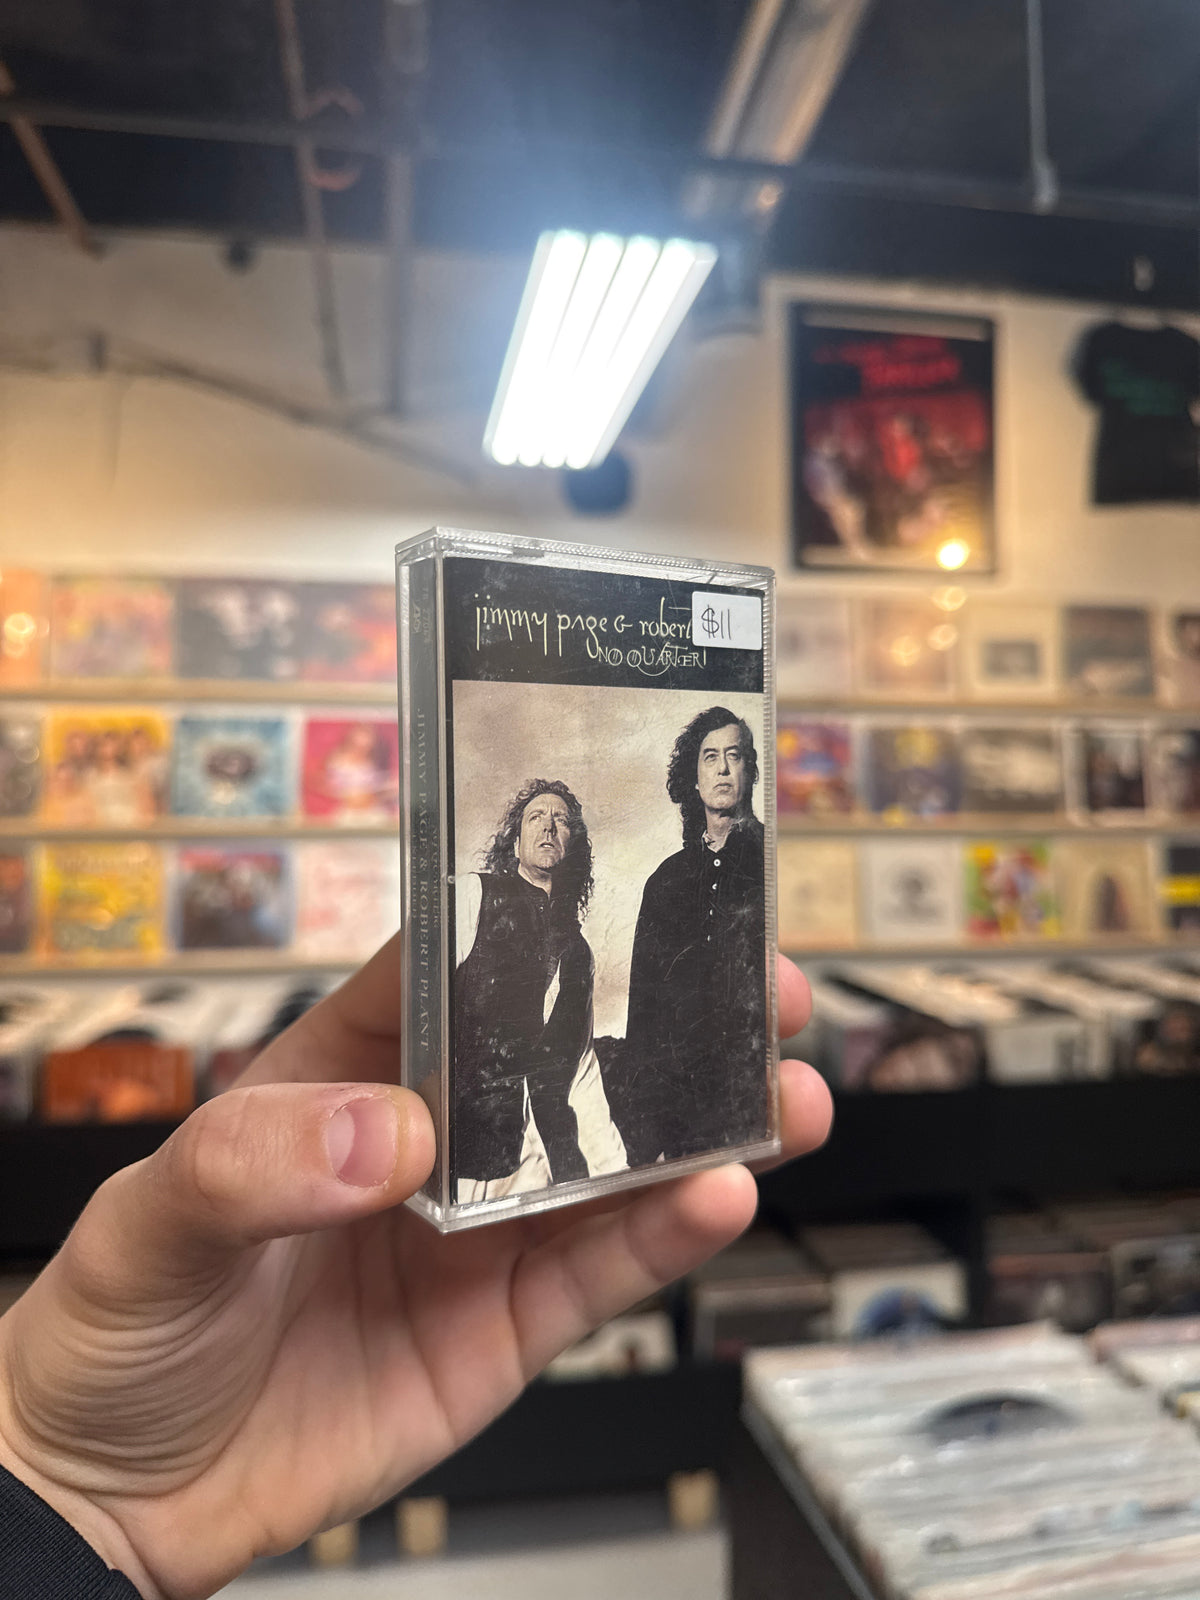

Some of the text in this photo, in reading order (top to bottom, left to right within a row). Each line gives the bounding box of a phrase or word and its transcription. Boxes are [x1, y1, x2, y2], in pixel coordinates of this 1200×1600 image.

[474, 593, 548, 657] jimmy
[557, 612, 608, 659] page
[700, 604, 732, 641] $11
[598, 646, 623, 667] NO
[627, 641, 705, 677] QUARTER
[416, 707, 429, 1053] JIMMY PAGE & ROBERT PLANT
